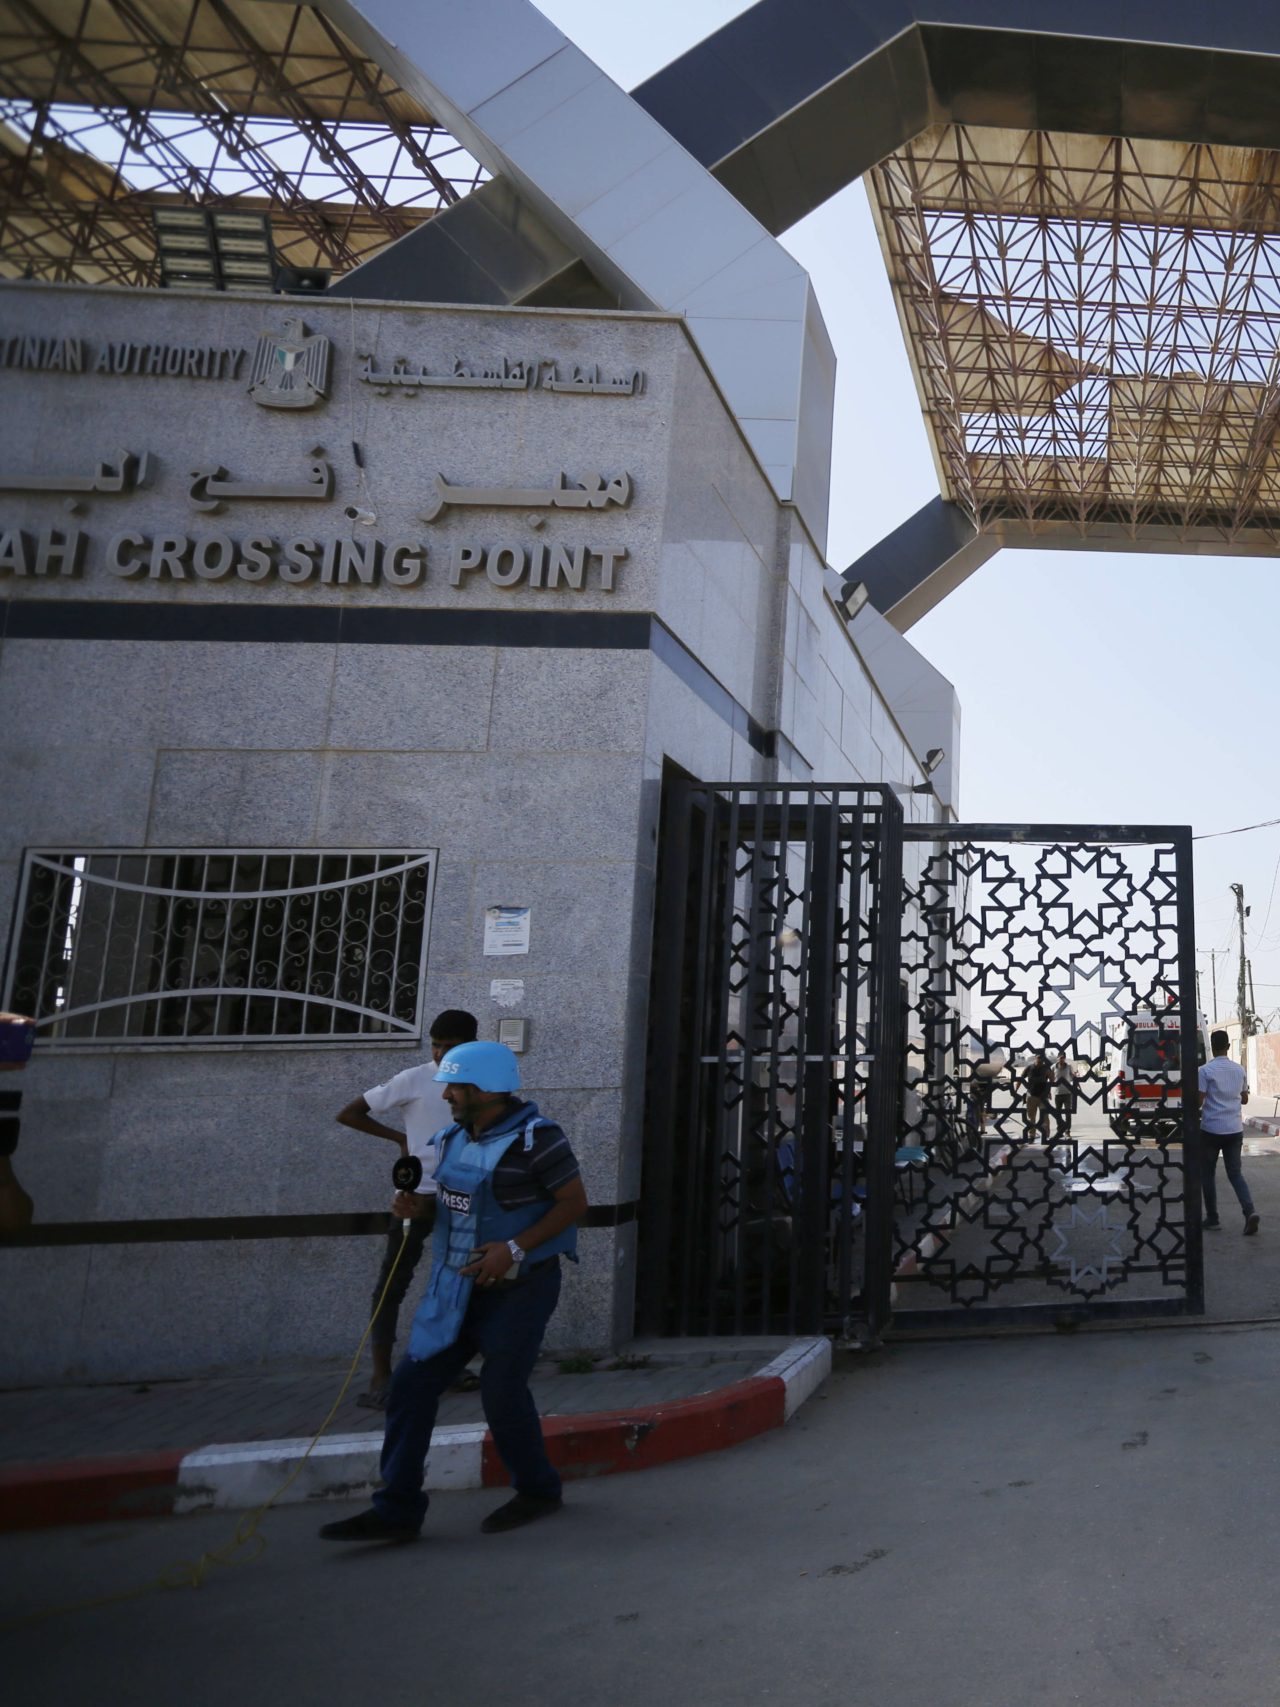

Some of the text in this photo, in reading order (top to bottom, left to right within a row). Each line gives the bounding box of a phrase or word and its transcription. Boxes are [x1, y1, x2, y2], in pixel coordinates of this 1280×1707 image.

[95, 343, 243, 377] AUTHORITY
[358, 354, 644, 396] السلطة الفلسطينية
[416, 471, 631, 526] معبر
[106, 530, 422, 586] CROSSING
[450, 539, 626, 590] POINT
